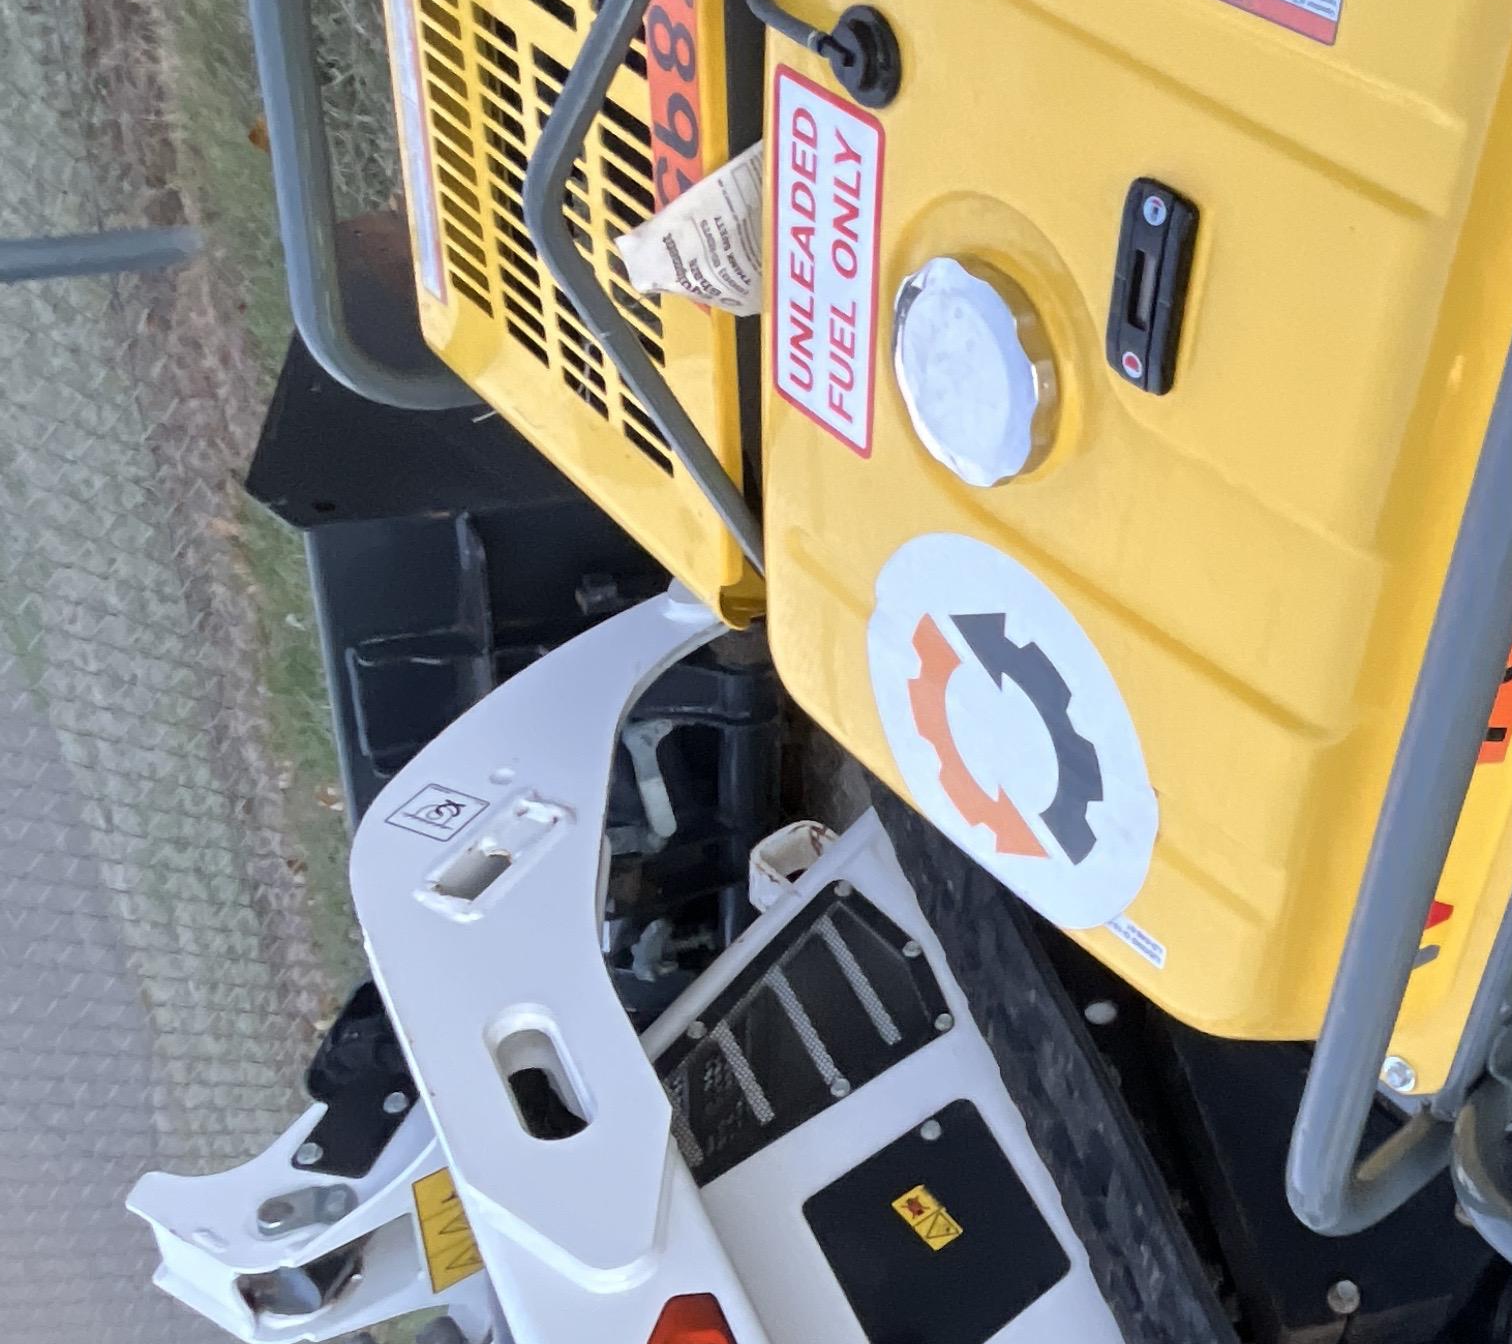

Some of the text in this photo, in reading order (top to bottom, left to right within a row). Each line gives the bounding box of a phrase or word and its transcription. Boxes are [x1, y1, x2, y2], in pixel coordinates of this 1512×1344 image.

[790, 107, 819, 393] UNLEADED
[829, 124, 863, 425] FUEL ONLY
